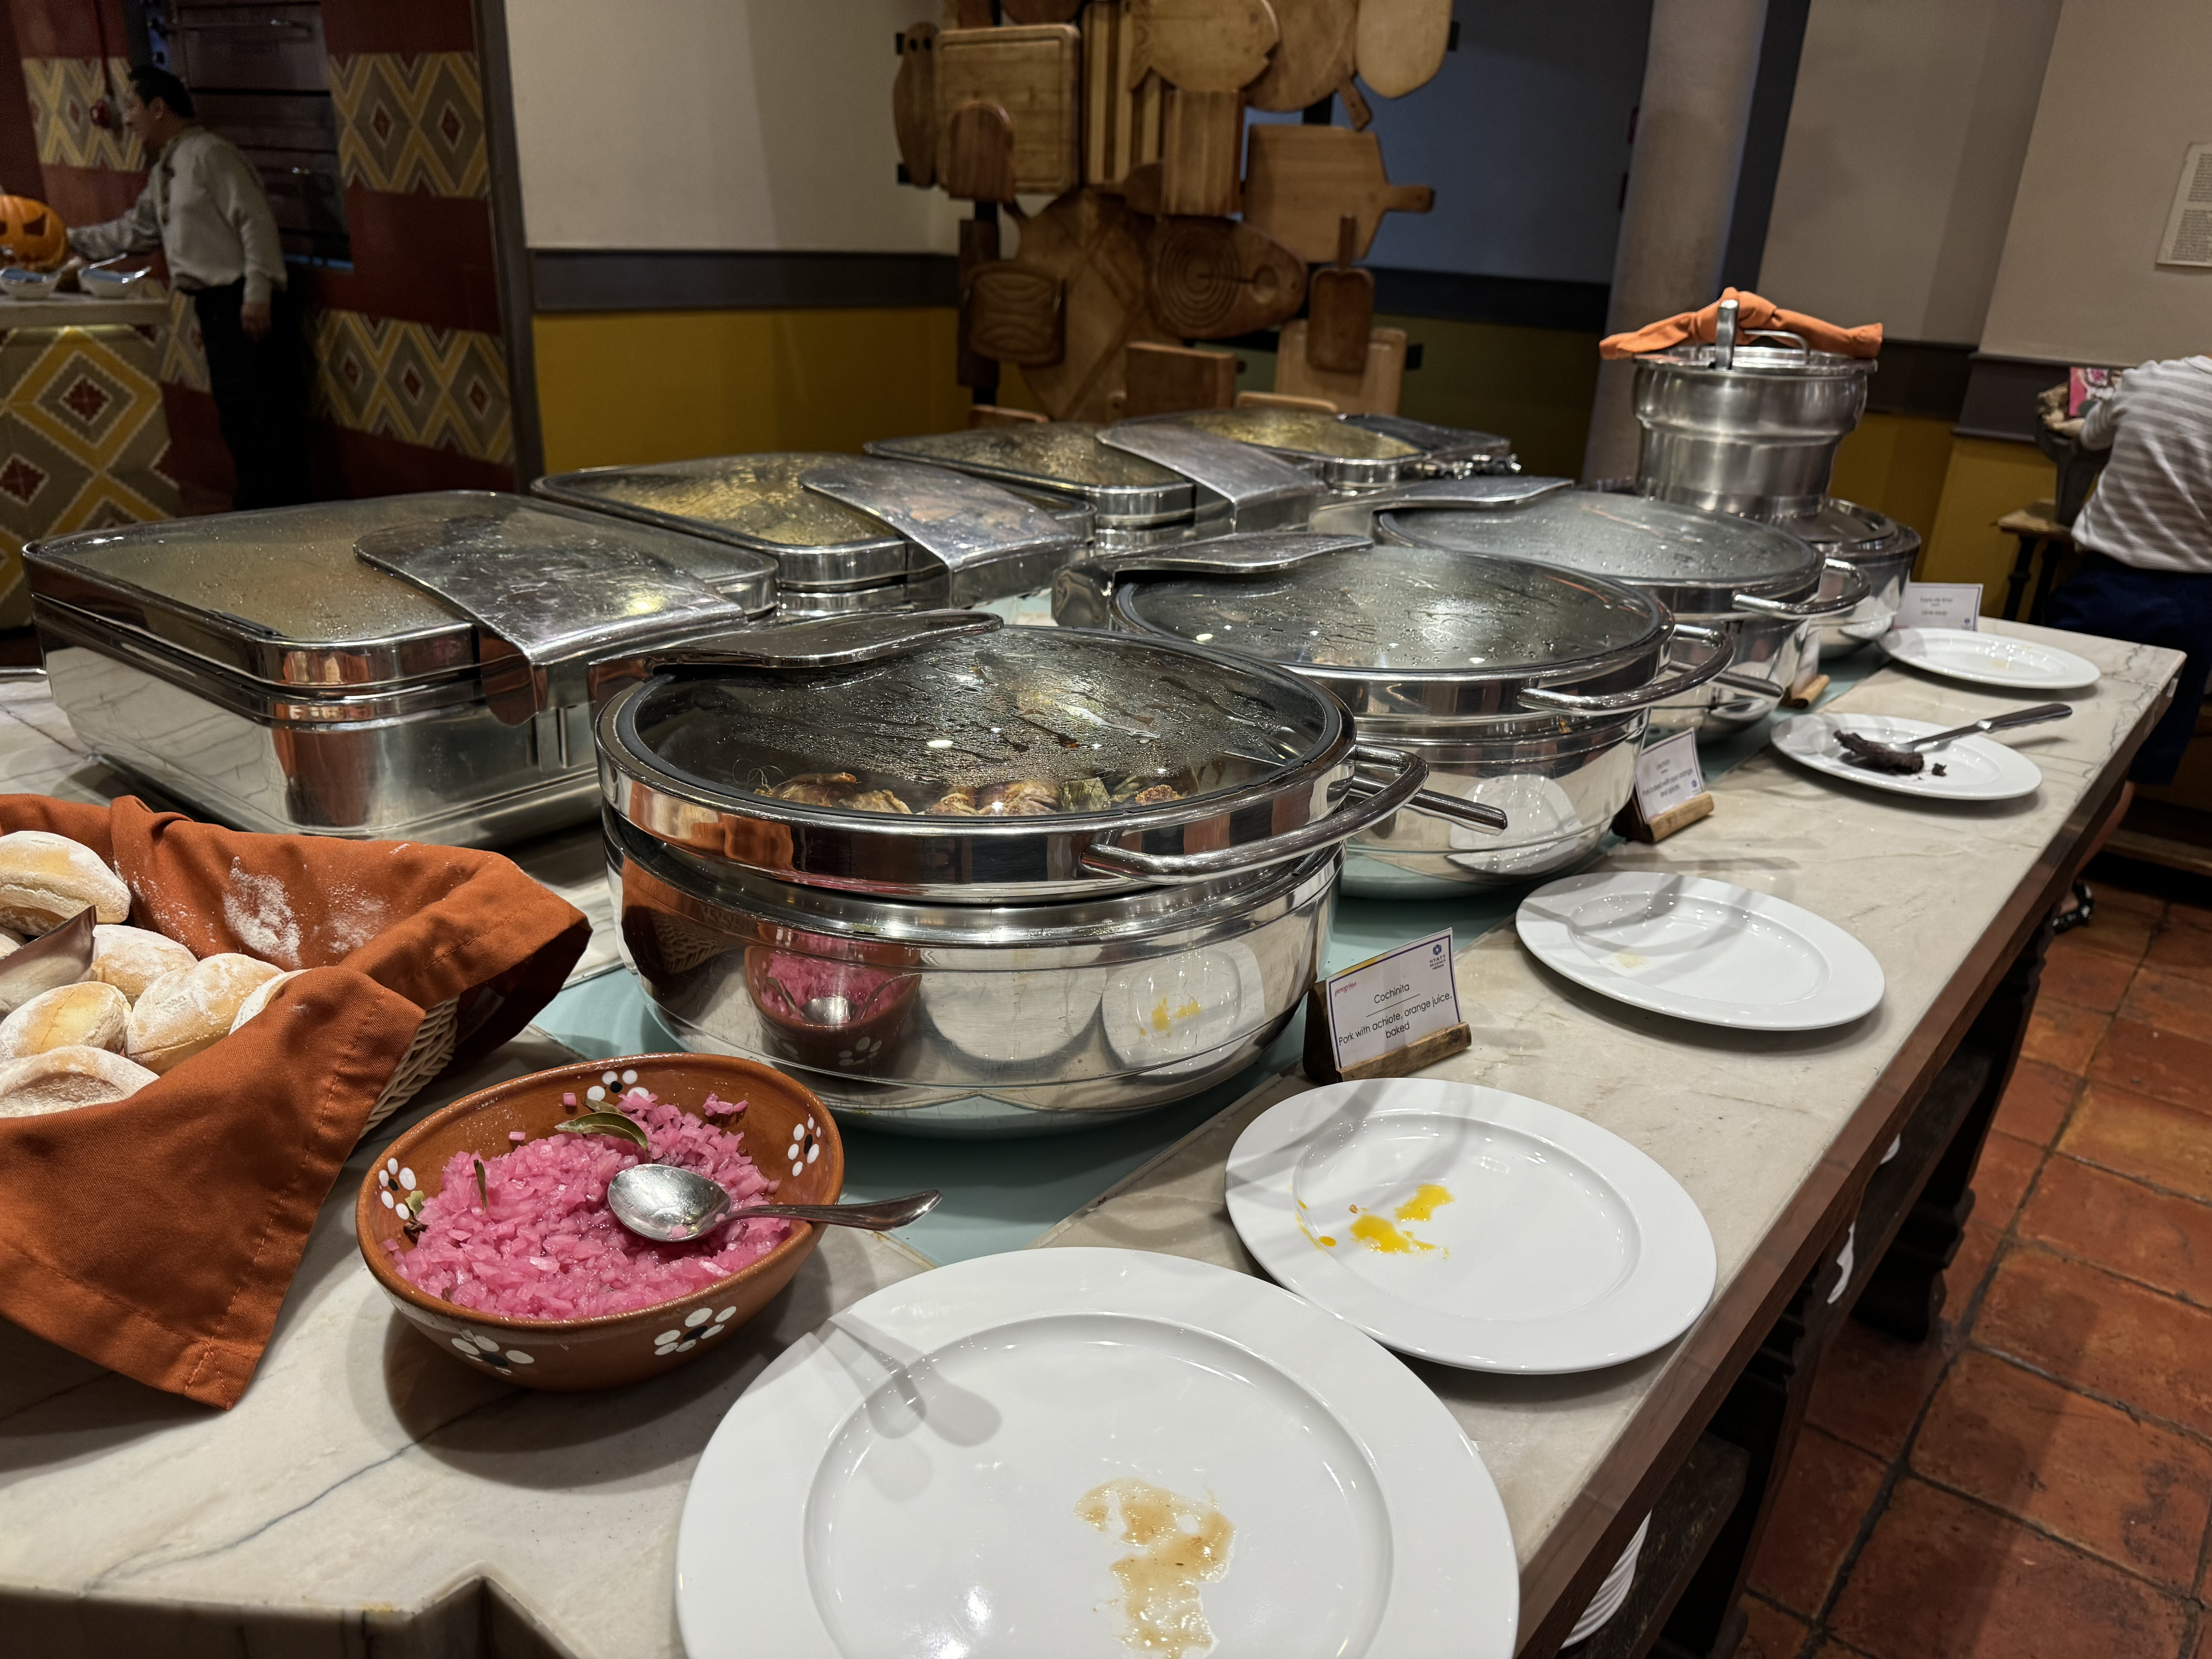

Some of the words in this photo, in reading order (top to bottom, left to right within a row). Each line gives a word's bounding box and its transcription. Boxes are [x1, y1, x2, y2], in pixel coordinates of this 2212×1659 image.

[1430, 954, 1445, 964] HYATT
[1334, 982, 1357, 997] peregrina
[1374, 984, 1410, 1003] Cochinita
[1338, 1032, 1354, 1046] Pork
[1355, 1025, 1371, 1037] with
[1372, 1013, 1403, 1030] achiote,
[1404, 1000, 1431, 1017] orange
[1432, 993, 1452, 1008] juice,
[1385, 1020, 1410, 1038] baked
